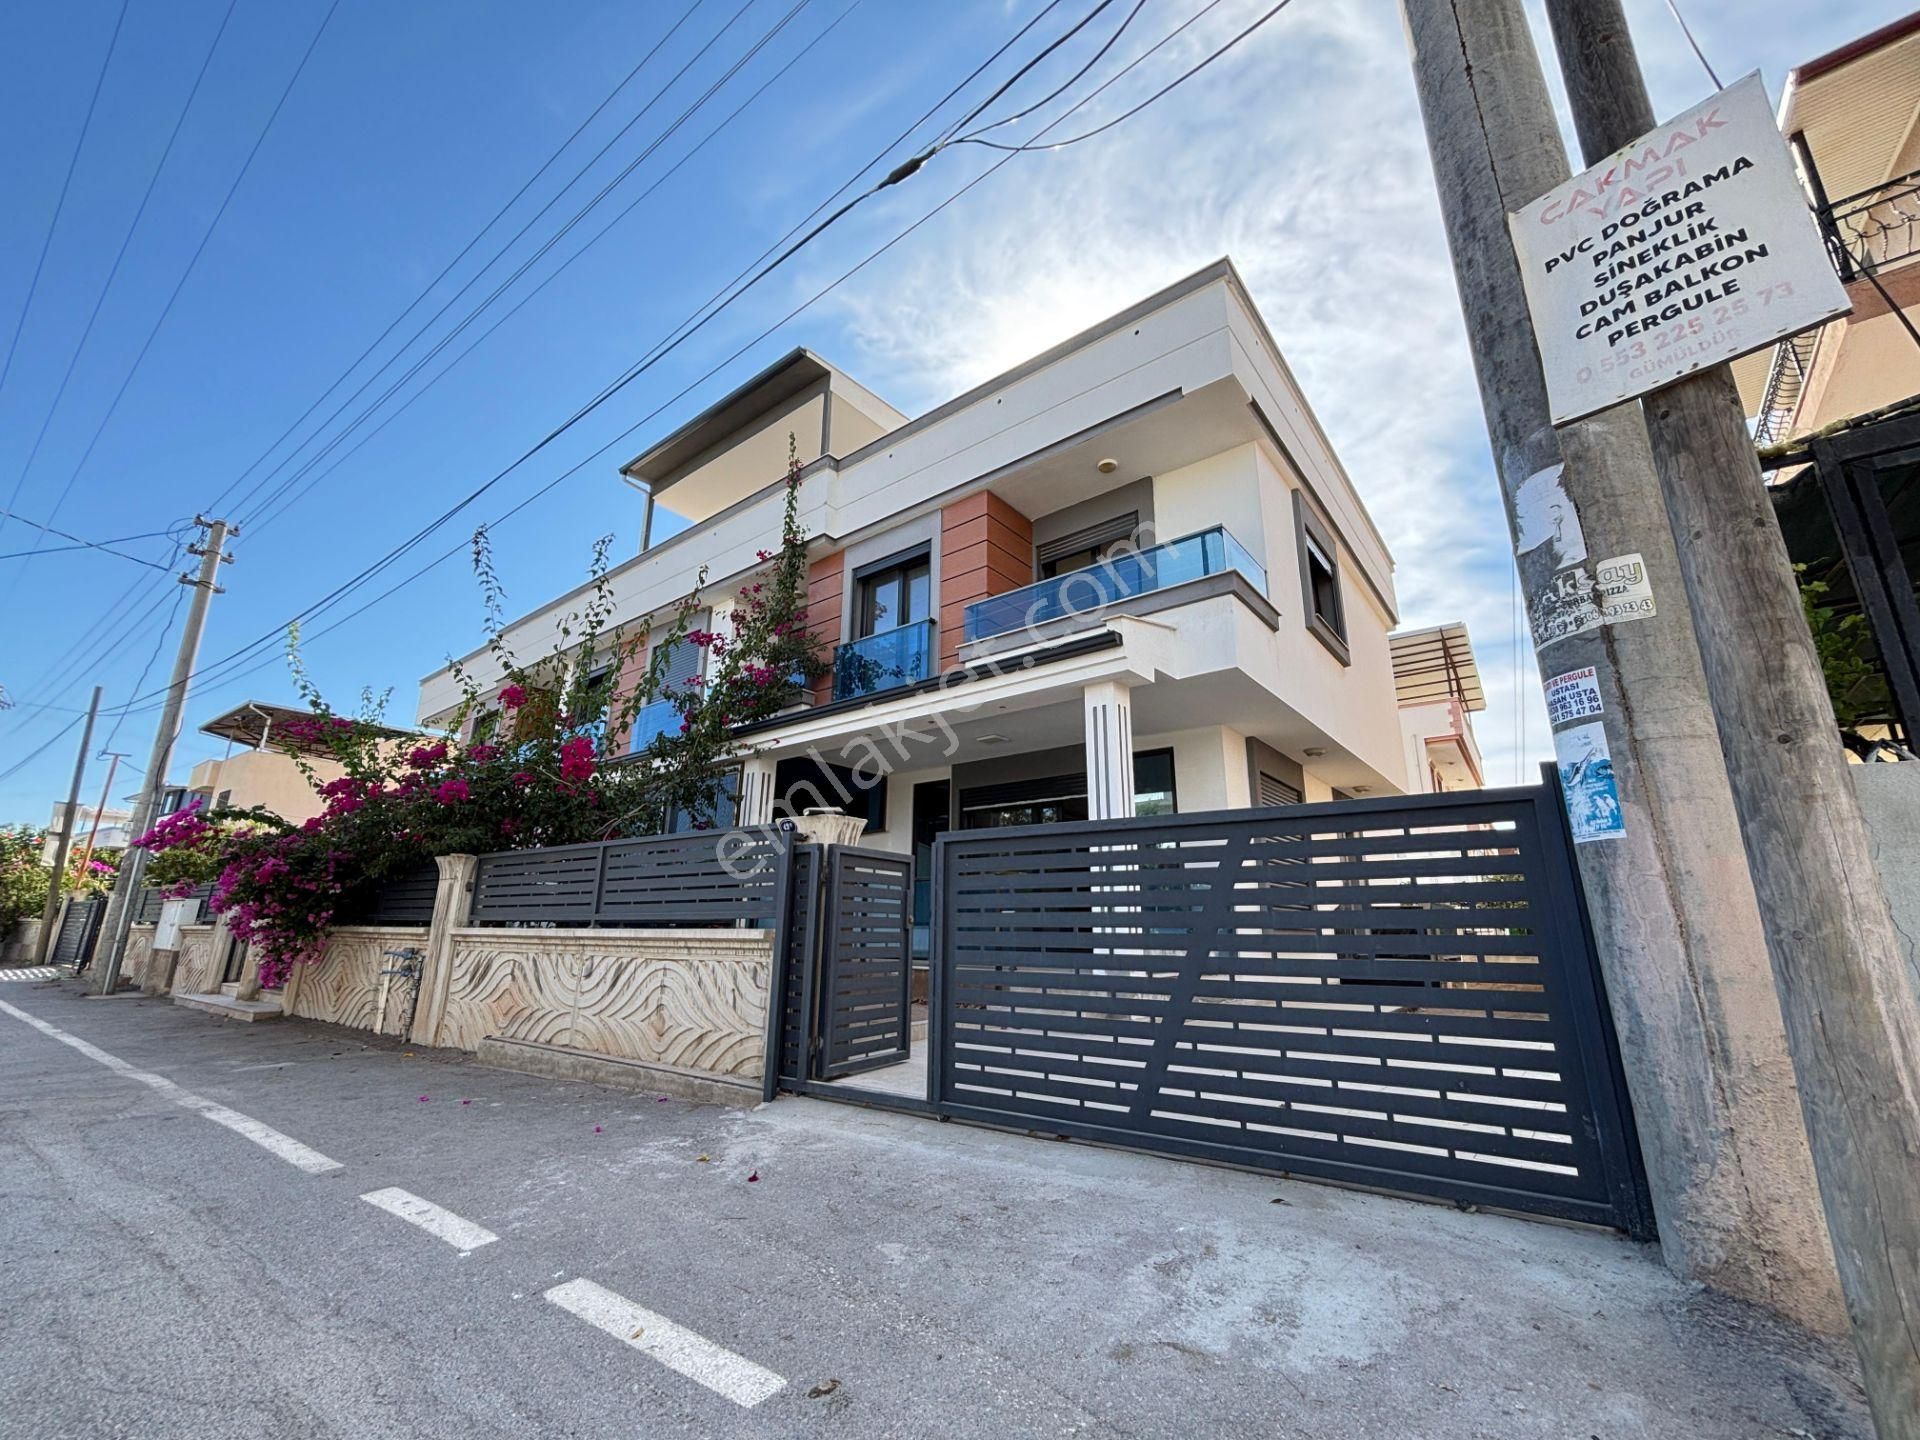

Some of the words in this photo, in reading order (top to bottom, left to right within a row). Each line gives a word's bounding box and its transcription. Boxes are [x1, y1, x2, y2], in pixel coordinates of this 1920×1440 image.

[1544, 236, 1594, 274] PVC
[1601, 155, 1755, 242] DOĞRAMA
[1588, 157, 1688, 219] YAPI
[1592, 201, 1706, 268] PANJUR
[1593, 215, 1721, 289] SİNEKLİK
[1575, 300, 1636, 340] CAM
[1645, 243, 1769, 308] BALKON
[1579, 228, 1750, 318] DUŞAKABİN
[1600, 341, 1647, 373] 553
[1654, 316, 1705, 350] 225
[1712, 300, 1749, 325] 25
[1756, 281, 1794, 306] 73
[1608, 278, 1741, 347] PERGULE
[1551, 682, 1580, 697] USTASI
[1560, 668, 1594, 684] PERGULE
[1569, 688, 1596, 700] USTA
[1574, 698, 1585, 707] 16
[1587, 695, 1600, 704] 96
[1561, 709, 1574, 720] 575
[1576, 707, 1586, 715] 47
[1589, 704, 1602, 713] 04
